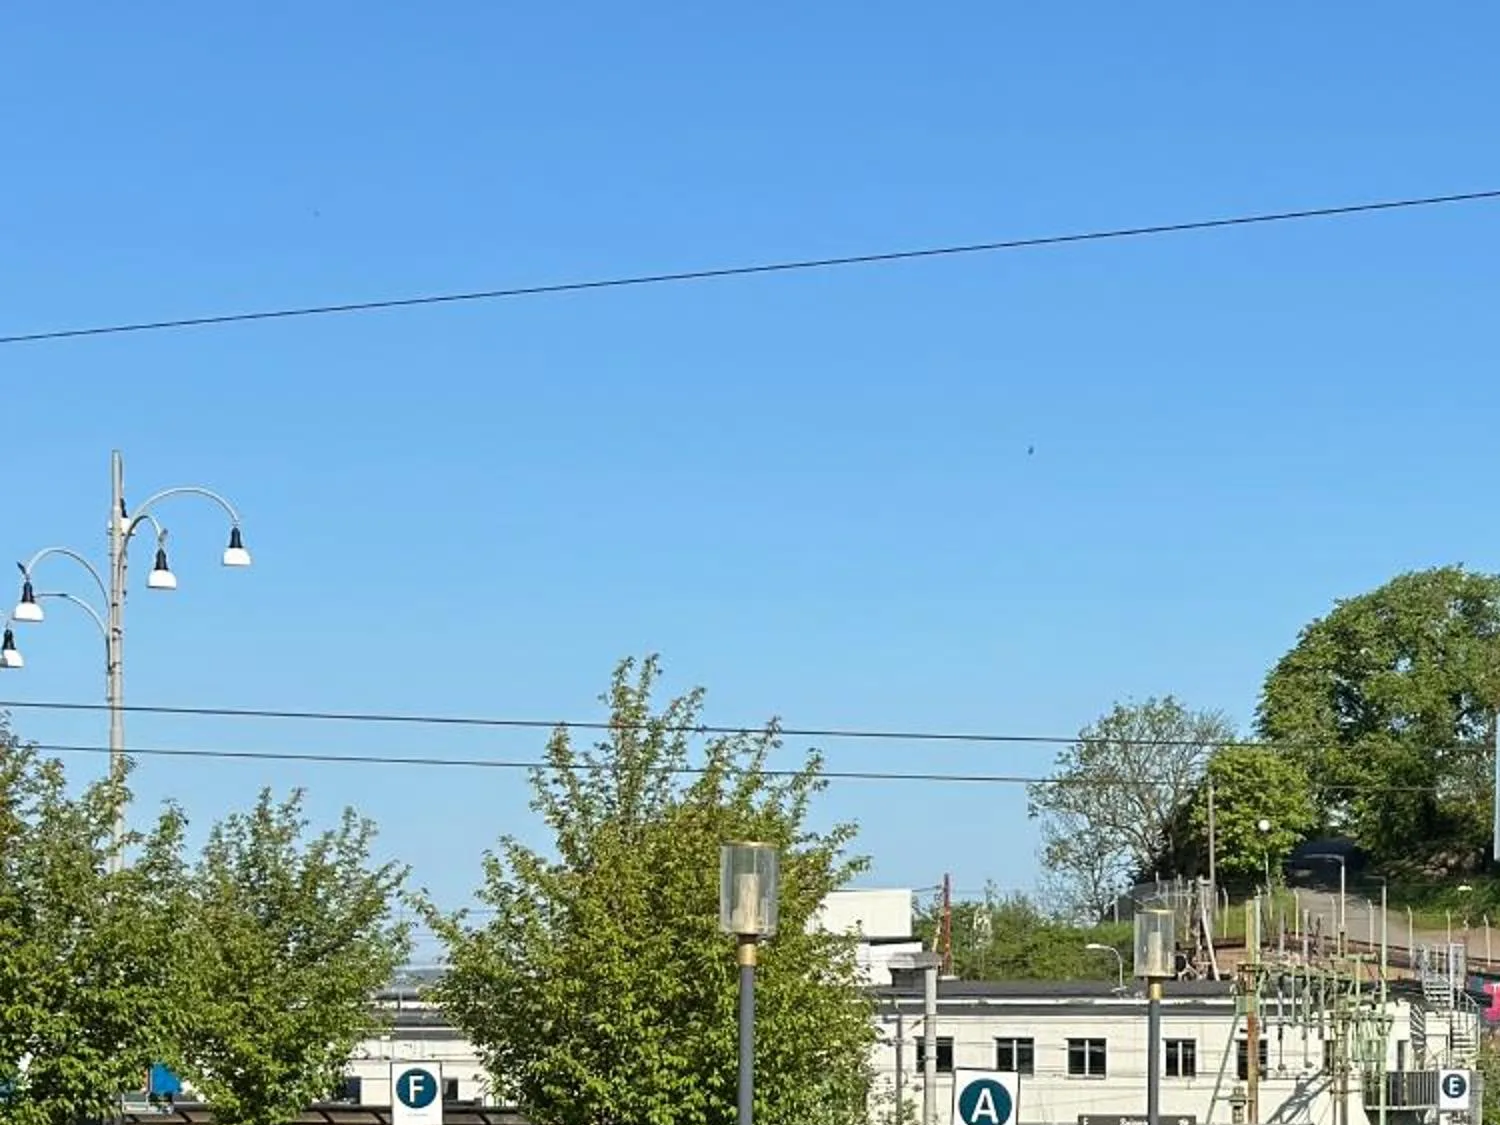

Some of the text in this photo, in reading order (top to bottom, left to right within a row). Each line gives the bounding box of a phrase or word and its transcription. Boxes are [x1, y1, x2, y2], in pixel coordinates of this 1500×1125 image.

[409, 1075, 425, 1103] F
[1449, 1077, 1460, 1095] E
[971, 1087, 999, 1124] A
